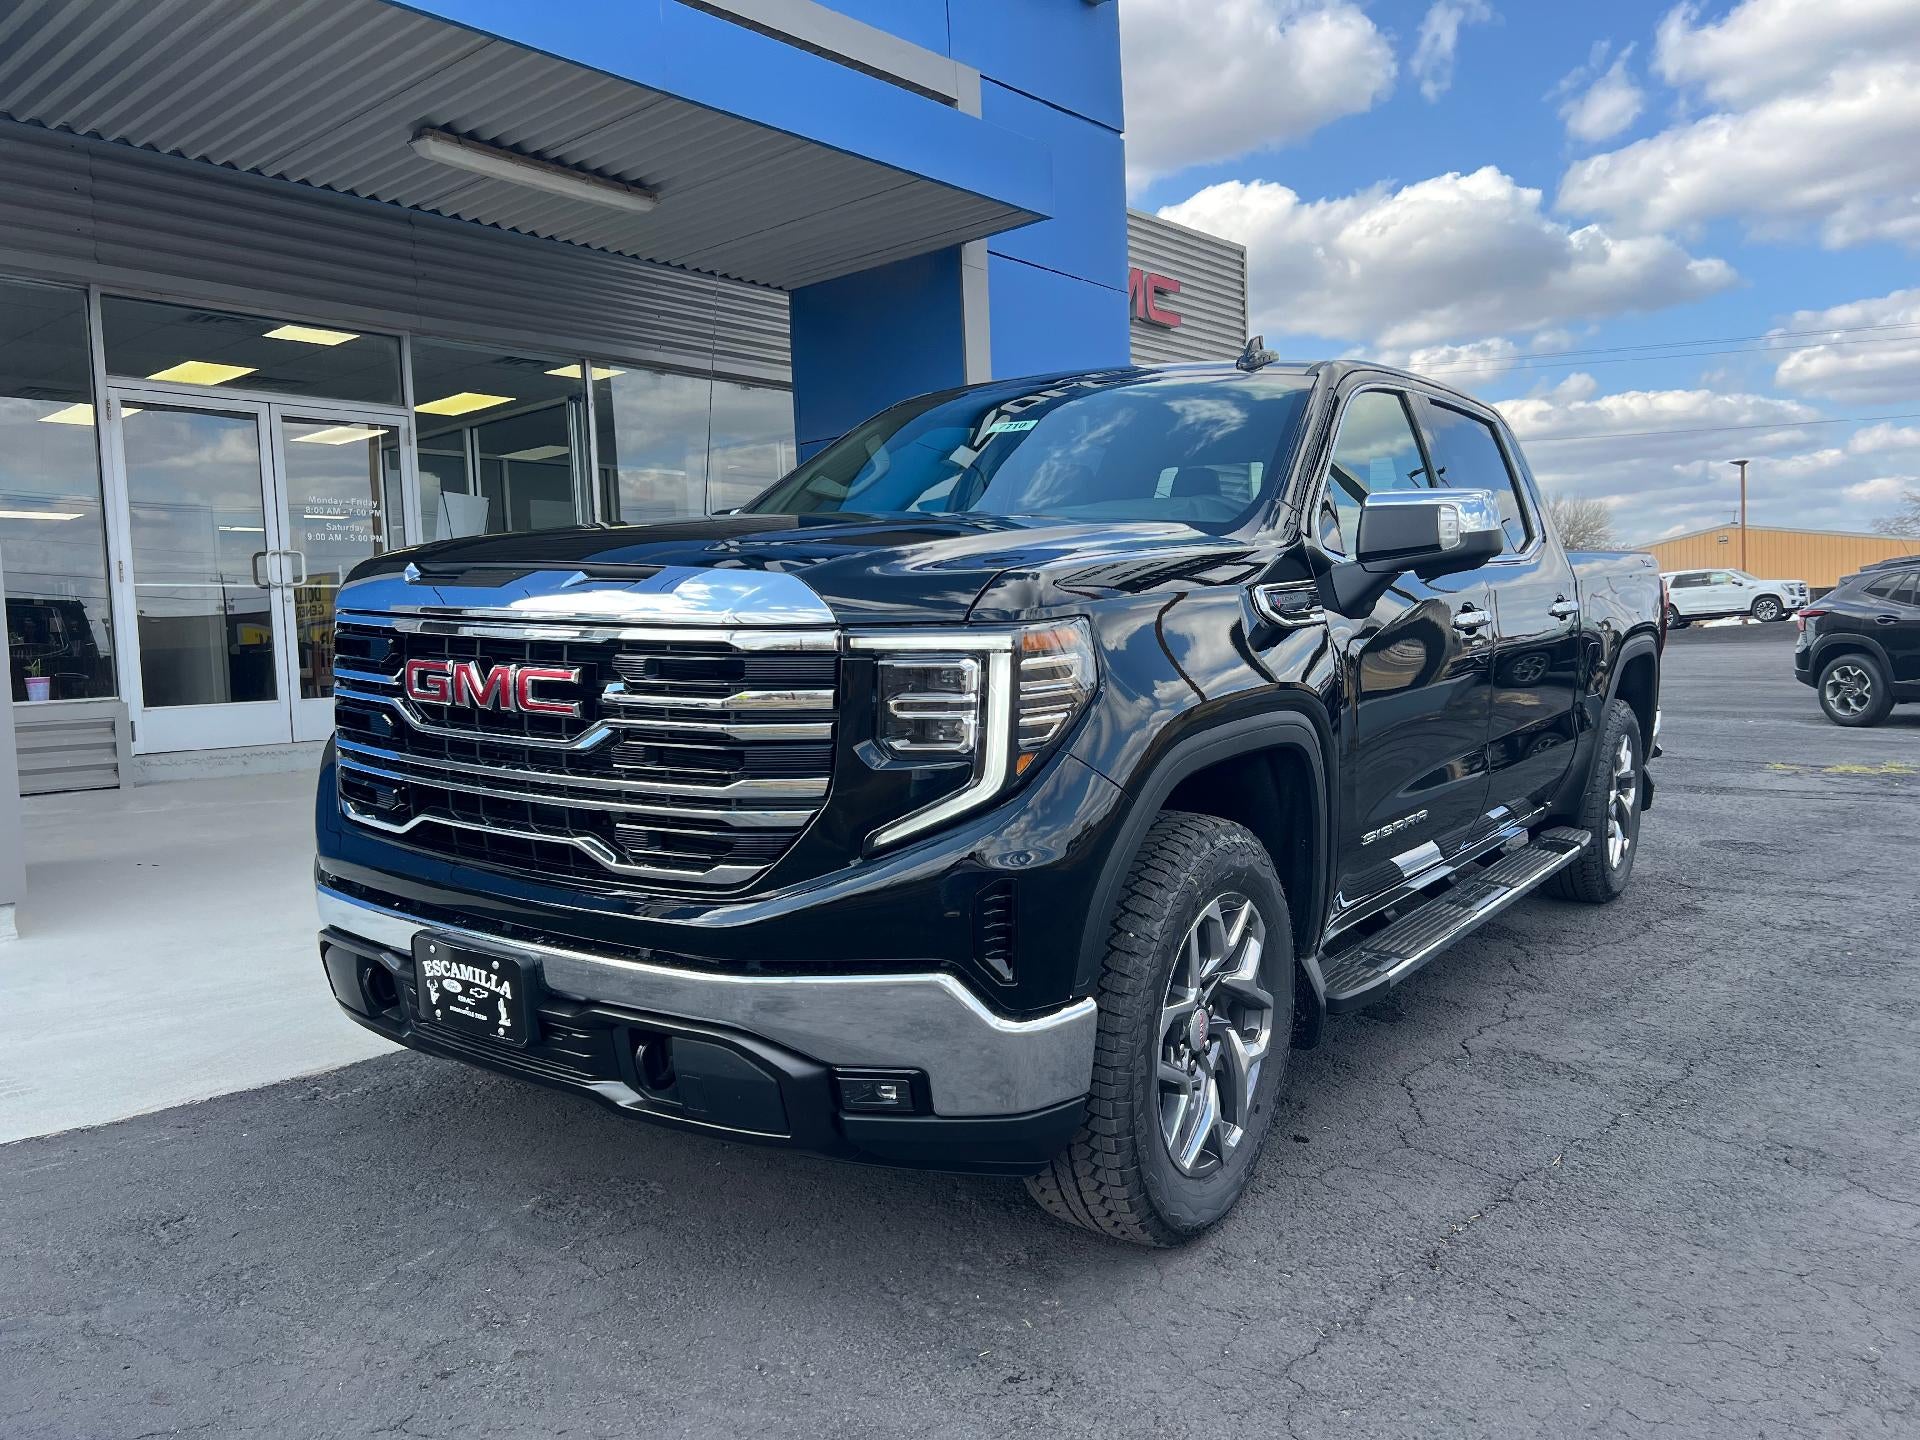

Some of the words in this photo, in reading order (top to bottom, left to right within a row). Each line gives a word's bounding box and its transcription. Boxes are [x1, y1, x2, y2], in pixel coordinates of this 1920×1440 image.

[308, 496, 343, 507] Monday
[351, 498, 378, 508] Friday
[305, 506, 324, 515] 8:00
[326, 507, 341, 515] AM
[349, 508, 366, 516] 7:00
[368, 509, 381, 517] PM
[326, 522, 365, 533] Saturday
[307, 533, 326, 541] 9:00
[328, 533, 342, 541] AM
[350, 534, 368, 542] 5:00
[370, 535, 383, 543] PM
[405, 658, 582, 718] GMC
[1360, 809, 1429, 846] SIERRA
[422, 959, 512, 1000] ESCAMILLA
